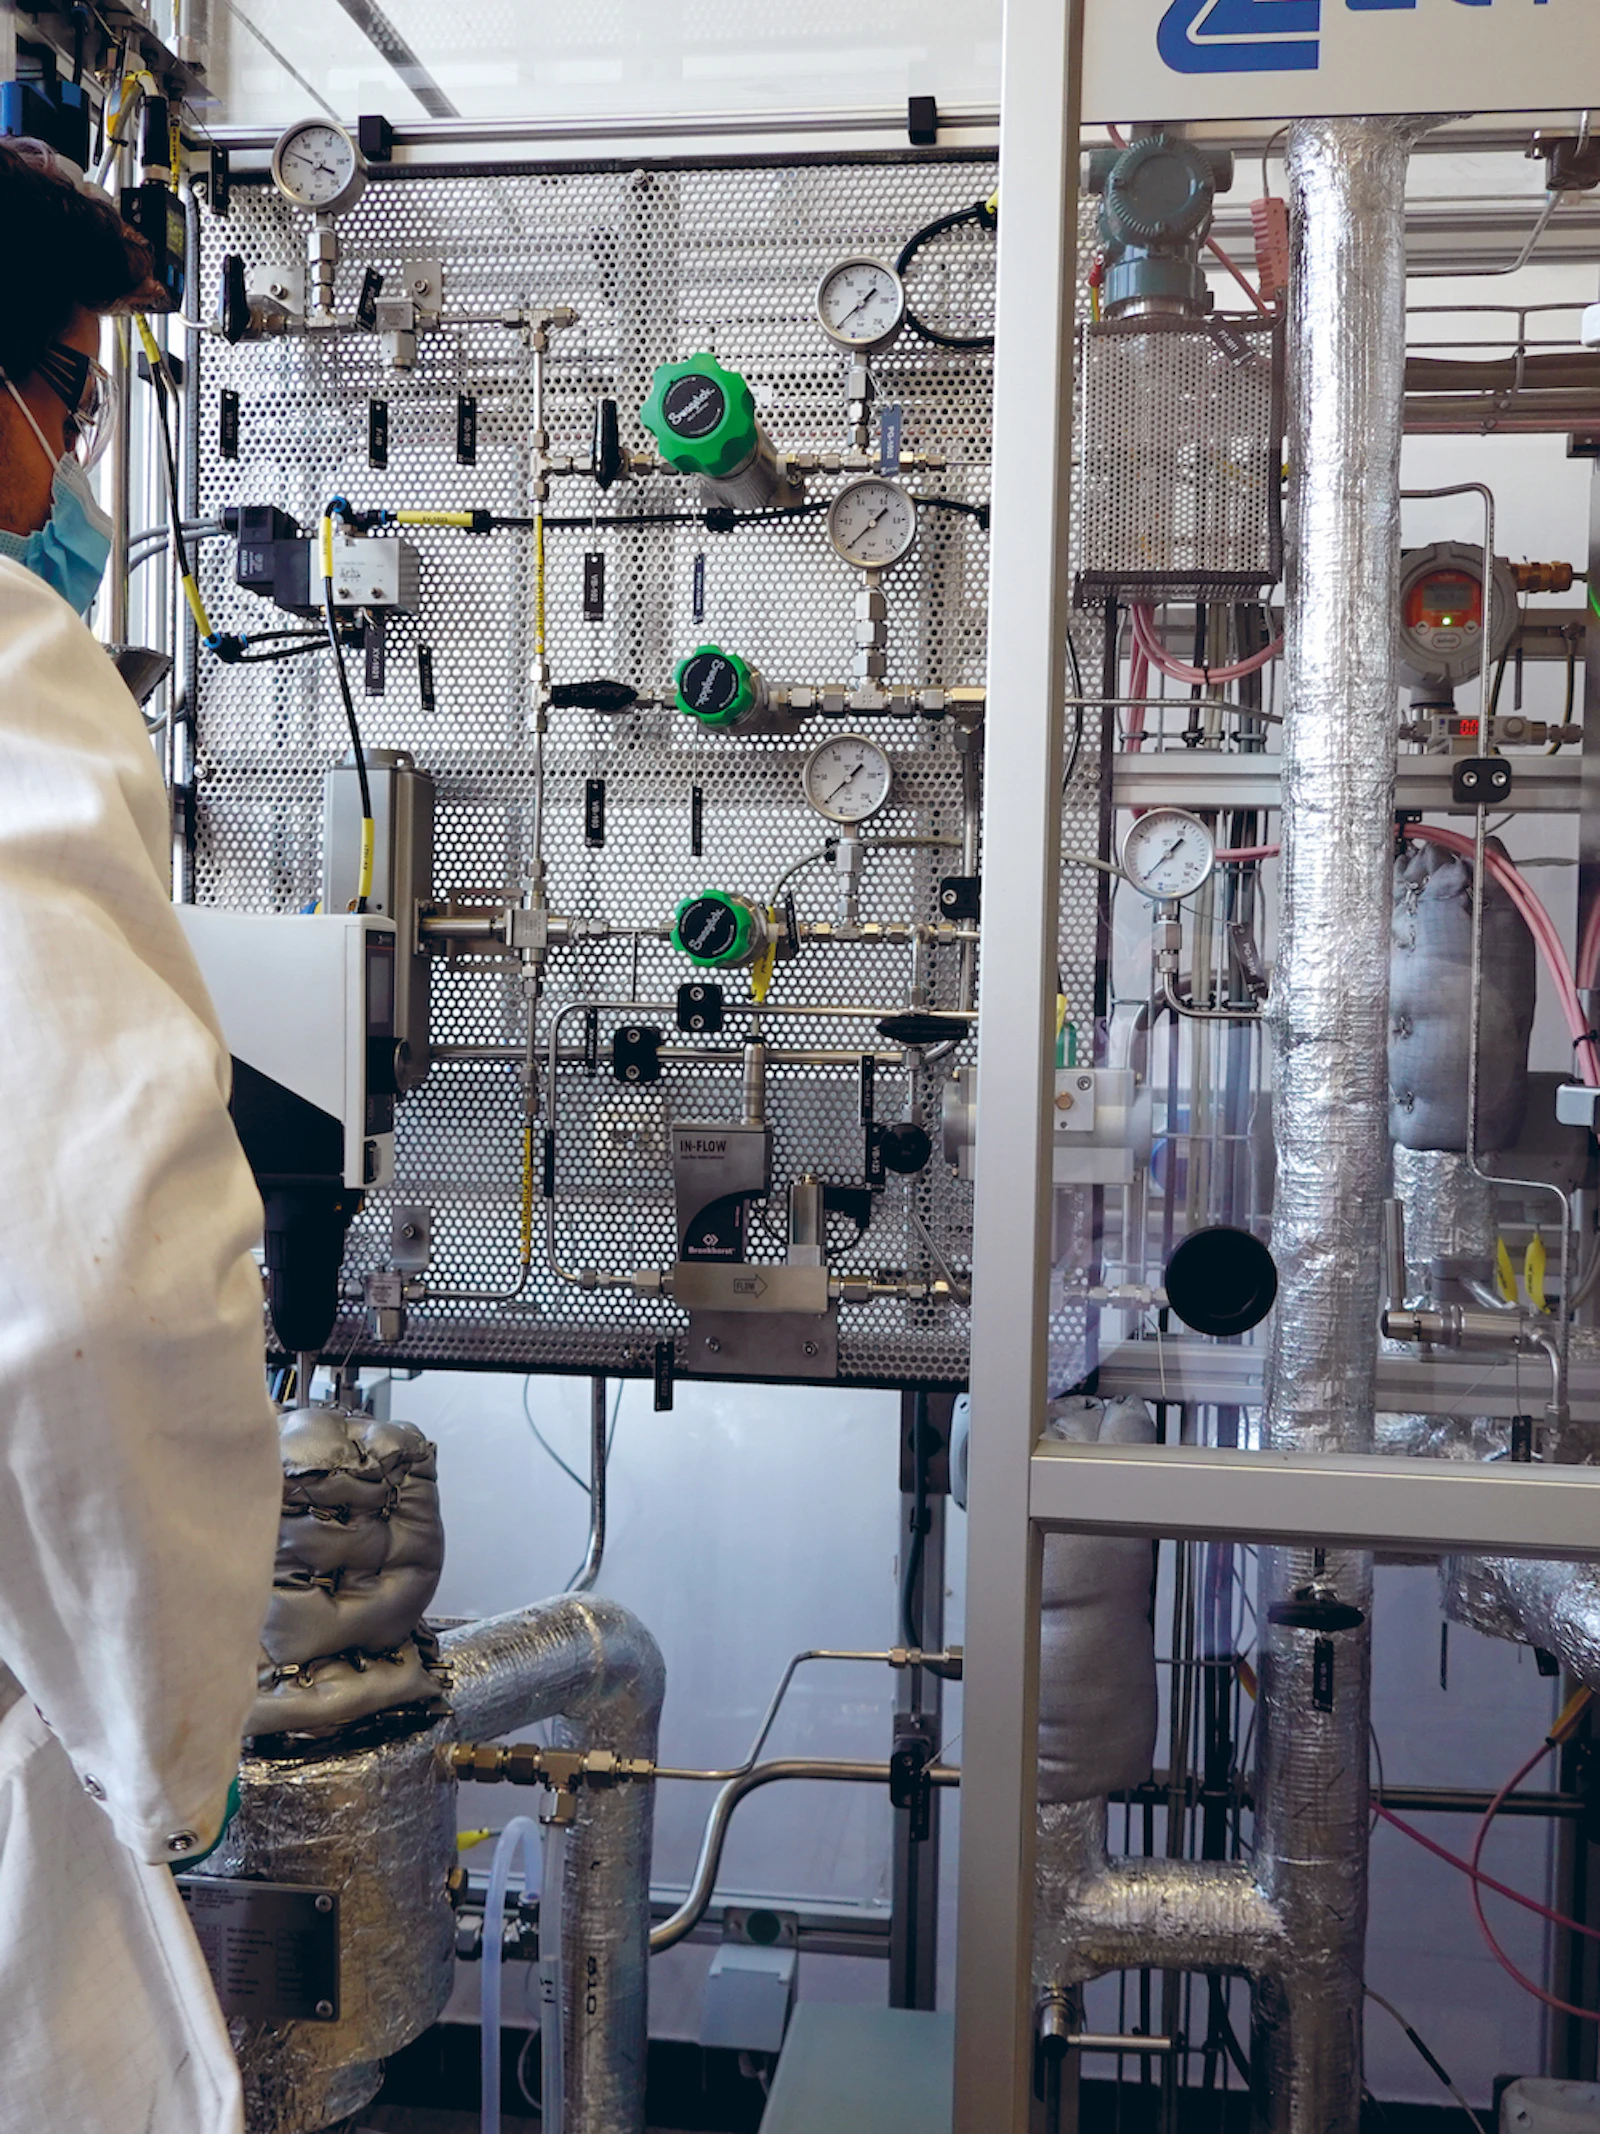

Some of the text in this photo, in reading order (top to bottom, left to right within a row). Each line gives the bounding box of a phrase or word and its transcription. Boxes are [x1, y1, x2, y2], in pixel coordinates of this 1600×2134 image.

[886, 425, 895, 460] PG-1002
[590, 574, 598, 603] VB-102
[590, 799, 600, 829] VB-103
[680, 1139, 727, 1152] IN-FLOW
[688, 1246, 735, 1256] Bronkhorst
[736, 1281, 755, 1291] FLOW
